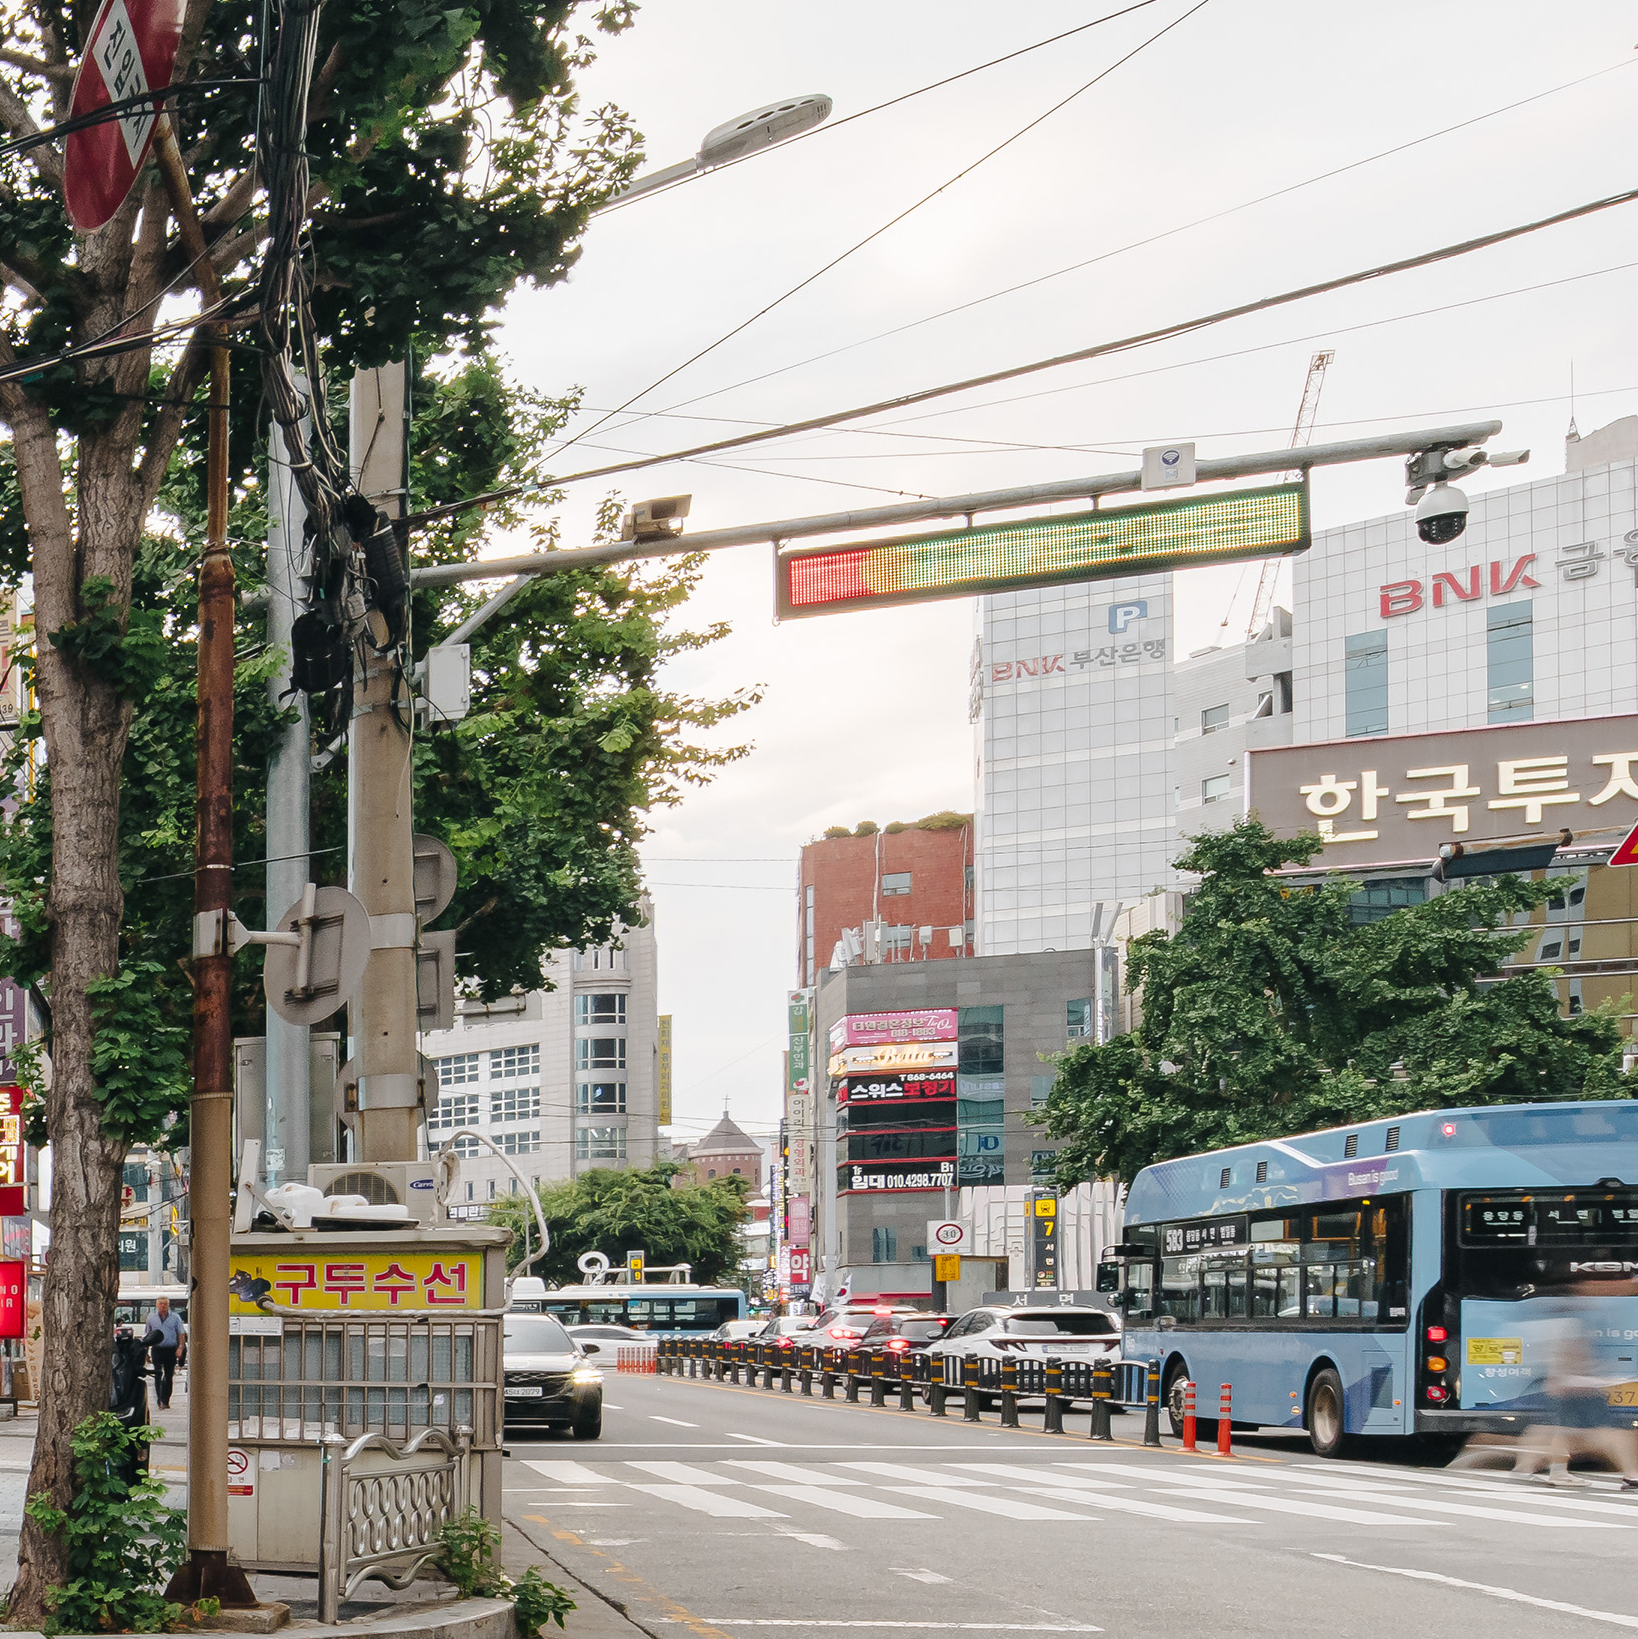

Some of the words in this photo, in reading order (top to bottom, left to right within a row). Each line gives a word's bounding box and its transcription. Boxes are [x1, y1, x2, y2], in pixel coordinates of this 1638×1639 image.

[1379, 552, 1543, 619] BNK
[1116, 606, 1141, 629] P
[991, 654, 1066, 682] BNK
[1070, 639, 1166, 670] 부산은행
[850, 1080, 956, 1099] 스위스보청기
[411, 1180, 434, 1189] Carri
[851, 1175, 885, 1190] 임대
[886, 1172, 954, 1189] 010.4298.7707
[1042, 1221, 1054, 1238] 7
[1165, 1228, 1184, 1253] 583
[790, 1252, 809, 1281] 약
[1044, 1243, 1054, 1267] 서면
[1569, 1261, 1638, 1273] KGM
[275, 1262, 468, 1306] 구두수선
